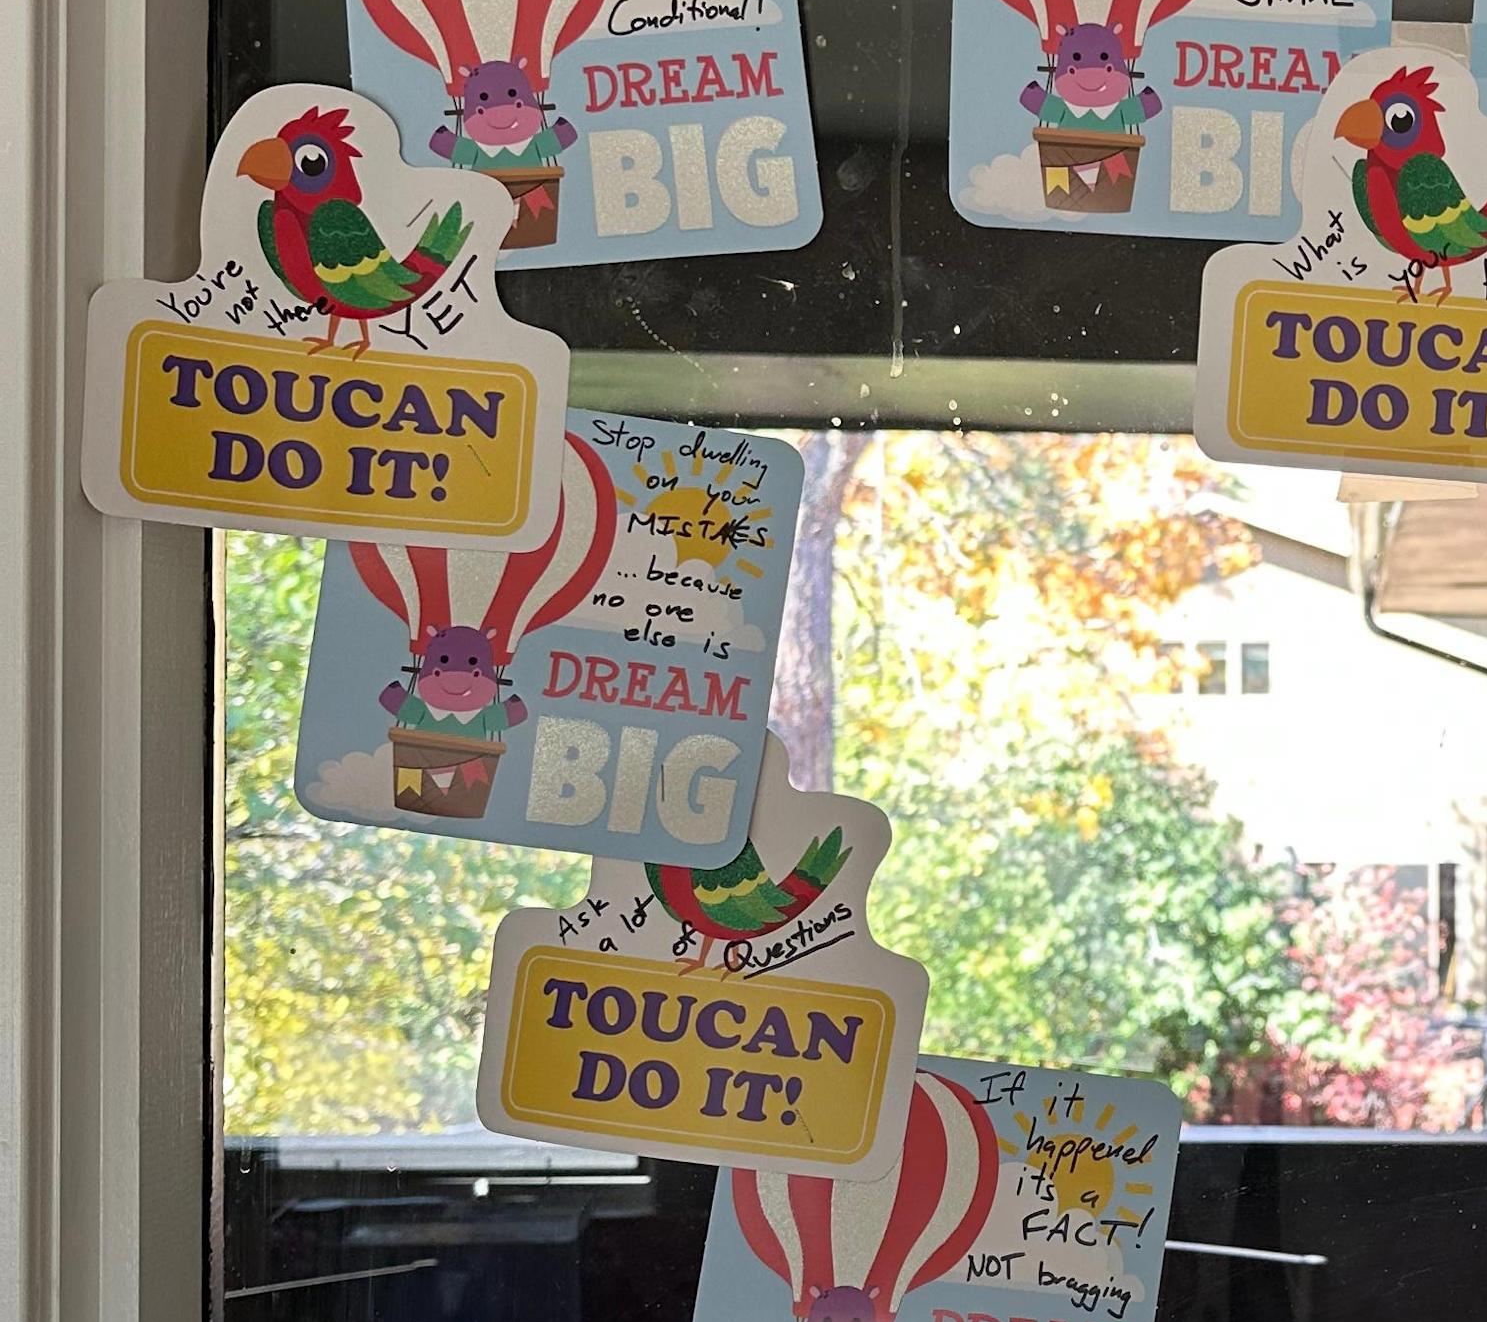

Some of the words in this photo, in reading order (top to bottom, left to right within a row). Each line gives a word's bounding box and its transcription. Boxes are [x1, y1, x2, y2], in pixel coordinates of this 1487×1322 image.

[582, 51, 785, 114] DREAM
[588, 115, 799, 237] BIG
[1271, 208, 1344, 282] What
[1335, 255, 1369, 282] is
[1388, 242, 1452, 304] your
[156, 258, 244, 325] You're
[225, 278, 261, 326] not
[266, 295, 337, 337] there
[378, 253, 480, 351] YET
[161, 354, 506, 439] TOUCAN
[1305, 378, 1410, 431] DO
[207, 430, 324, 490] DO
[346, 446, 451, 503] IT!
[592, 418, 657, 463] Stop
[678, 430, 770, 489] dwelling
[645, 474, 680, 492] on
[706, 483, 761, 516] your
[591, 592, 626, 609] no
[645, 601, 696, 622] one
[622, 619, 677, 649] else
[703, 631, 730, 661] is
[541, 650, 751, 721] DREAM
[525, 714, 742, 846] BIG
[557, 897, 611, 946] Ask
[599, 936, 619, 952] a
[619, 892, 656, 935] lot
[671, 918, 699, 957] of
[722, 901, 854, 975] Questions
[543, 977, 865, 1065] TOUCAN
[571, 1050, 681, 1110] DO
[699, 1067, 804, 1127] IT!
[972, 1069, 1027, 1107] If
[1047, 1081, 1085, 1118] it
[1021, 1206, 1155, 1250] FACT!
[1079, 1188, 1101, 1208] a
[965, 1252, 1027, 1283] NOT
[1037, 1260, 1134, 1320] bragging
